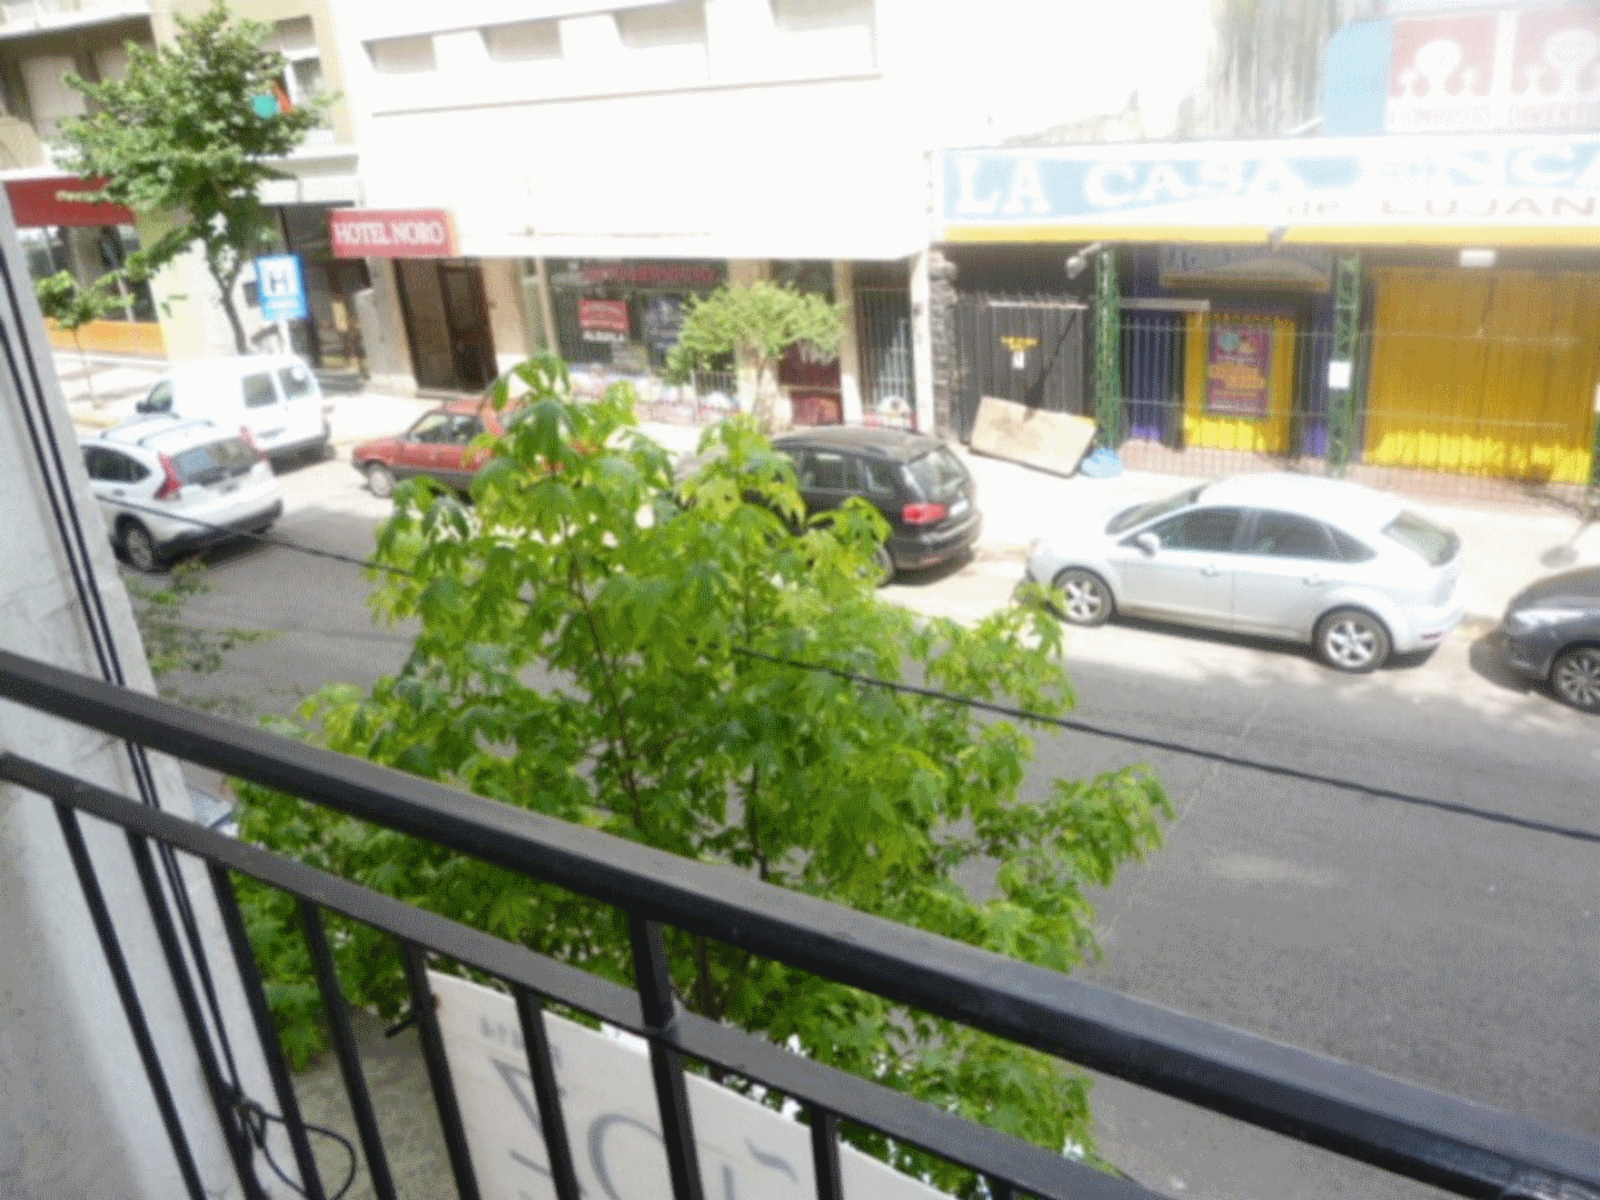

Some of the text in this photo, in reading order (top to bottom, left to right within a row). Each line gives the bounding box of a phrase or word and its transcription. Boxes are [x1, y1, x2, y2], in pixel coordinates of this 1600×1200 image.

[955, 156, 1050, 214] LA
[1082, 155, 1303, 207] CASA
[334, 221, 391, 245] HOTEL
